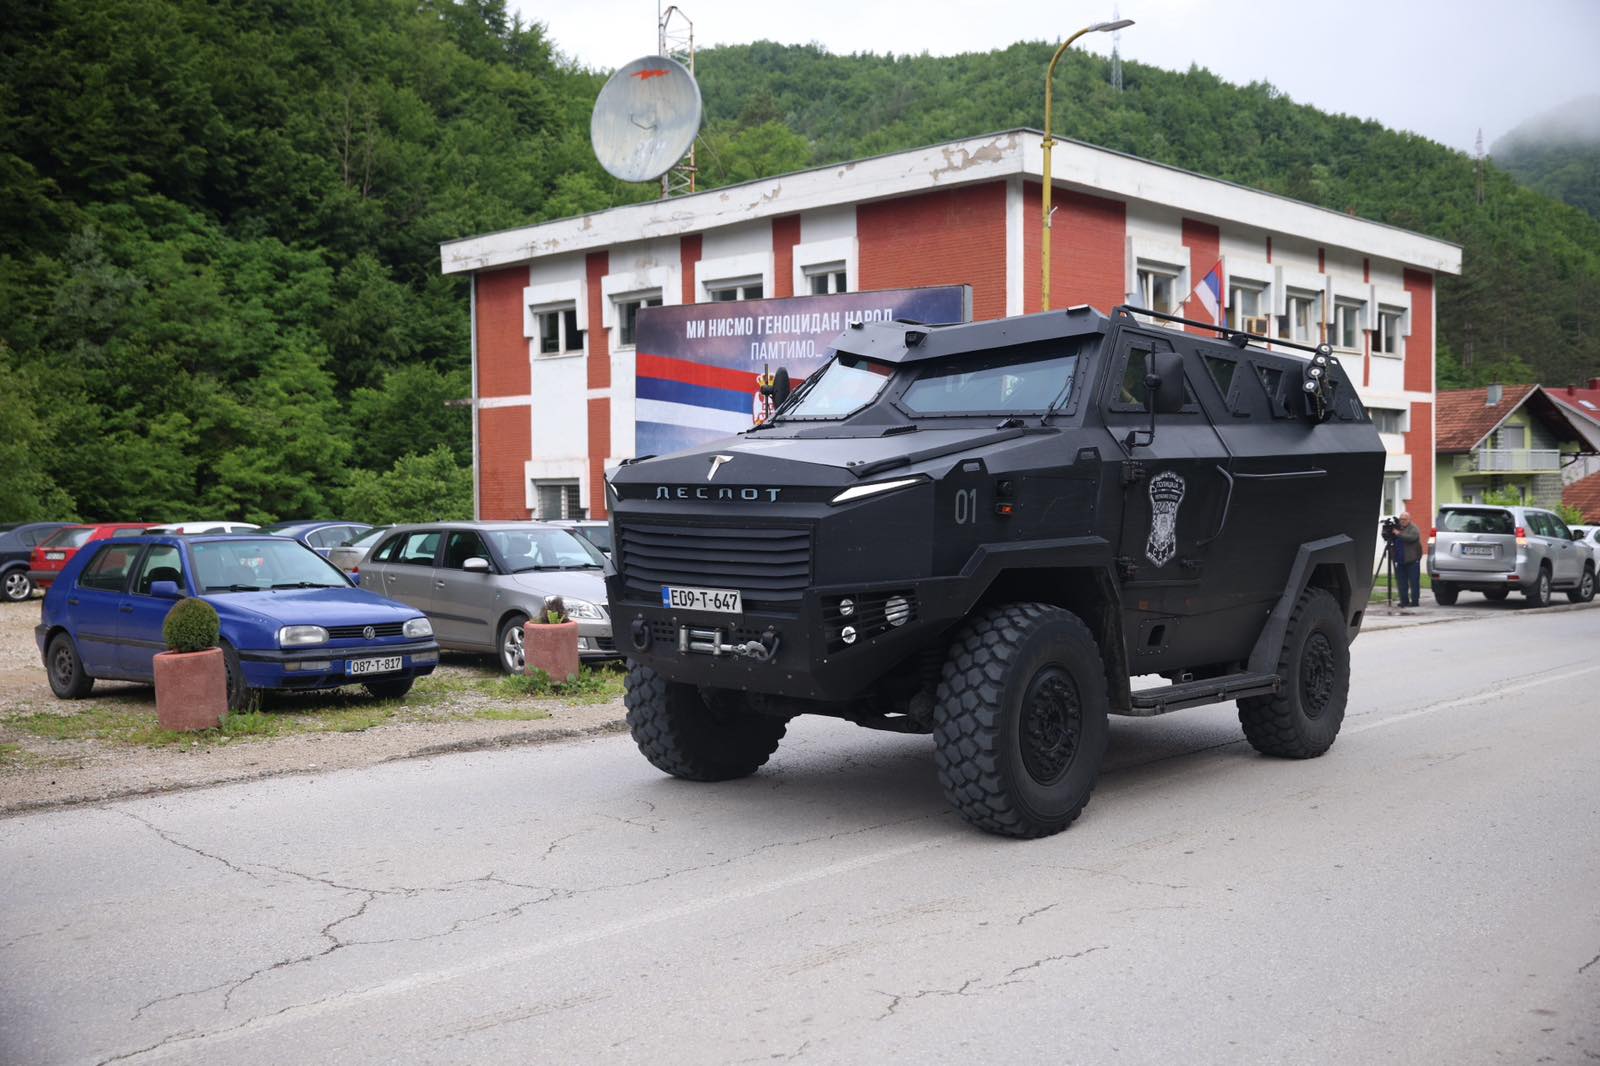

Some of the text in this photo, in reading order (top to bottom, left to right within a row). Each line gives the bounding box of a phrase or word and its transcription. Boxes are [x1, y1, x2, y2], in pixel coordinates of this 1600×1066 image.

[686, 319, 705, 339] МИ
[708, 317, 753, 337] НИСМО
[757, 312, 840, 335] ГЕНОЦИДАН
[955, 488, 977, 525] 01
[671, 589, 738, 611] E09-T-647
[352, 657, 401, 673] 087-T-817
